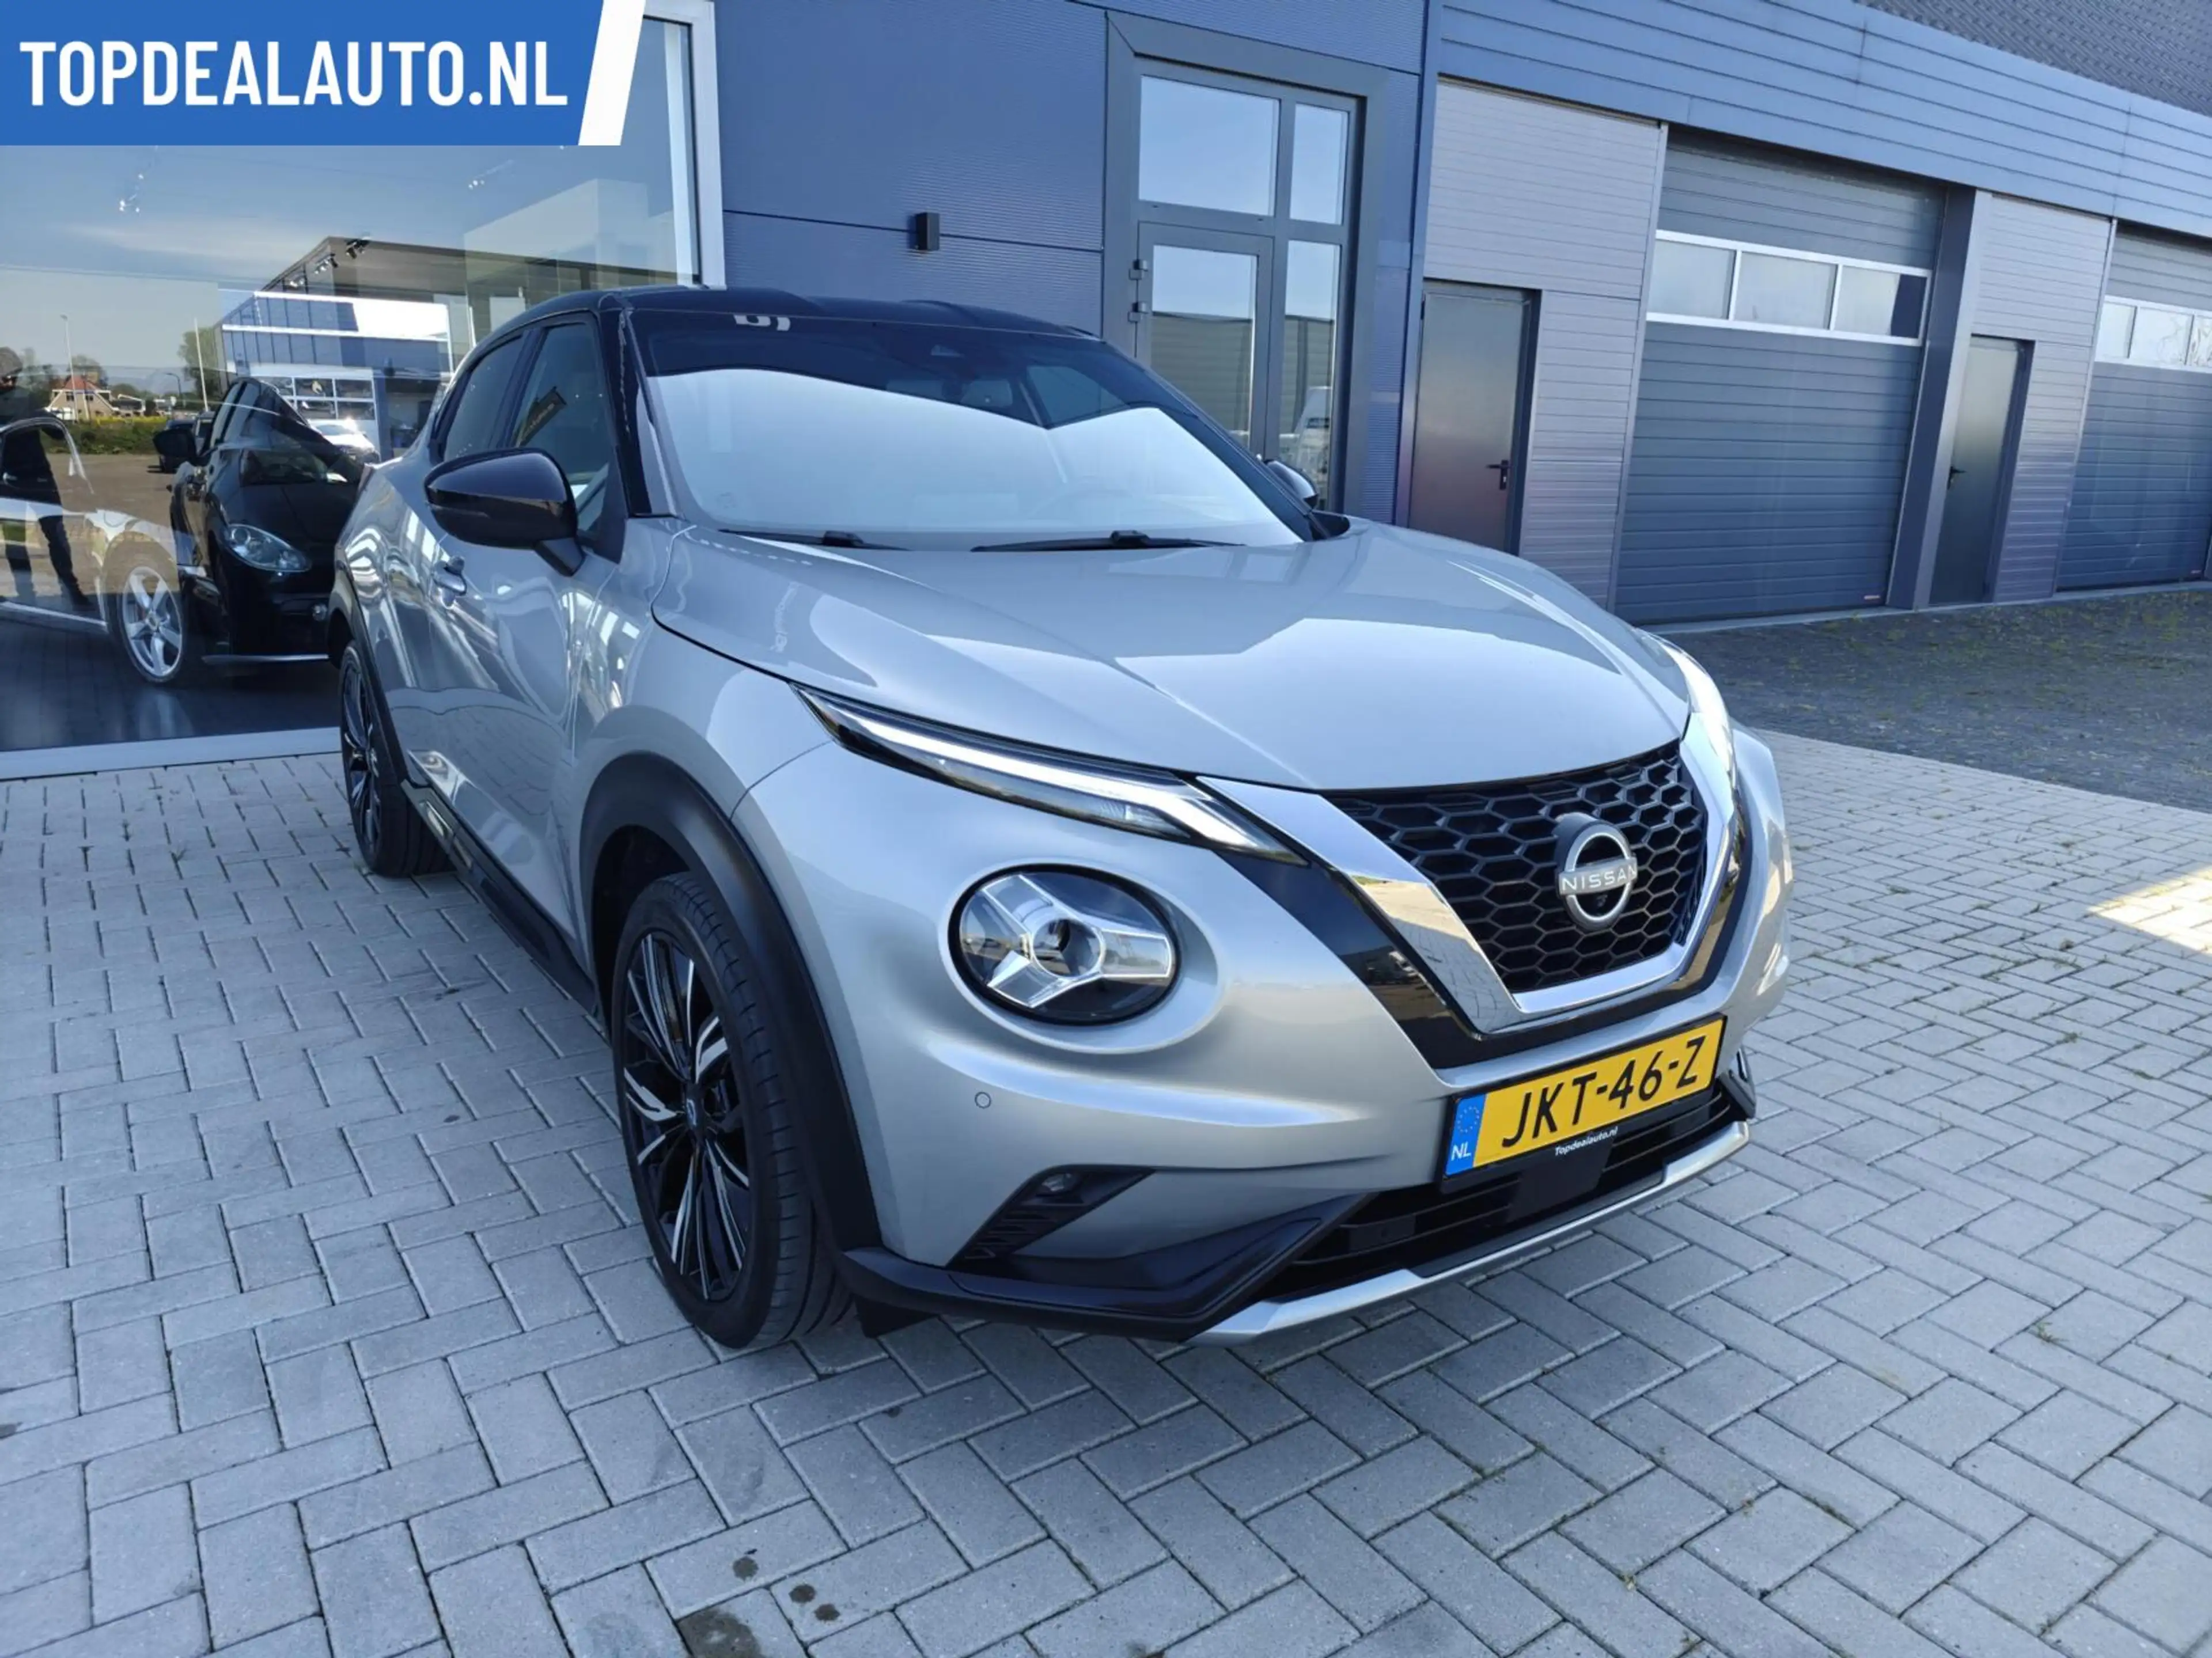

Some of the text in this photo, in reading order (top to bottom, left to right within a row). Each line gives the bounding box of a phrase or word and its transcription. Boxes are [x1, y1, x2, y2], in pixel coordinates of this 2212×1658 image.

[1562, 865, 1637, 891] NISSAN
[1501, 1035, 1706, 1147] JKT-46-Z
[1450, 1141, 1472, 1162] NL
